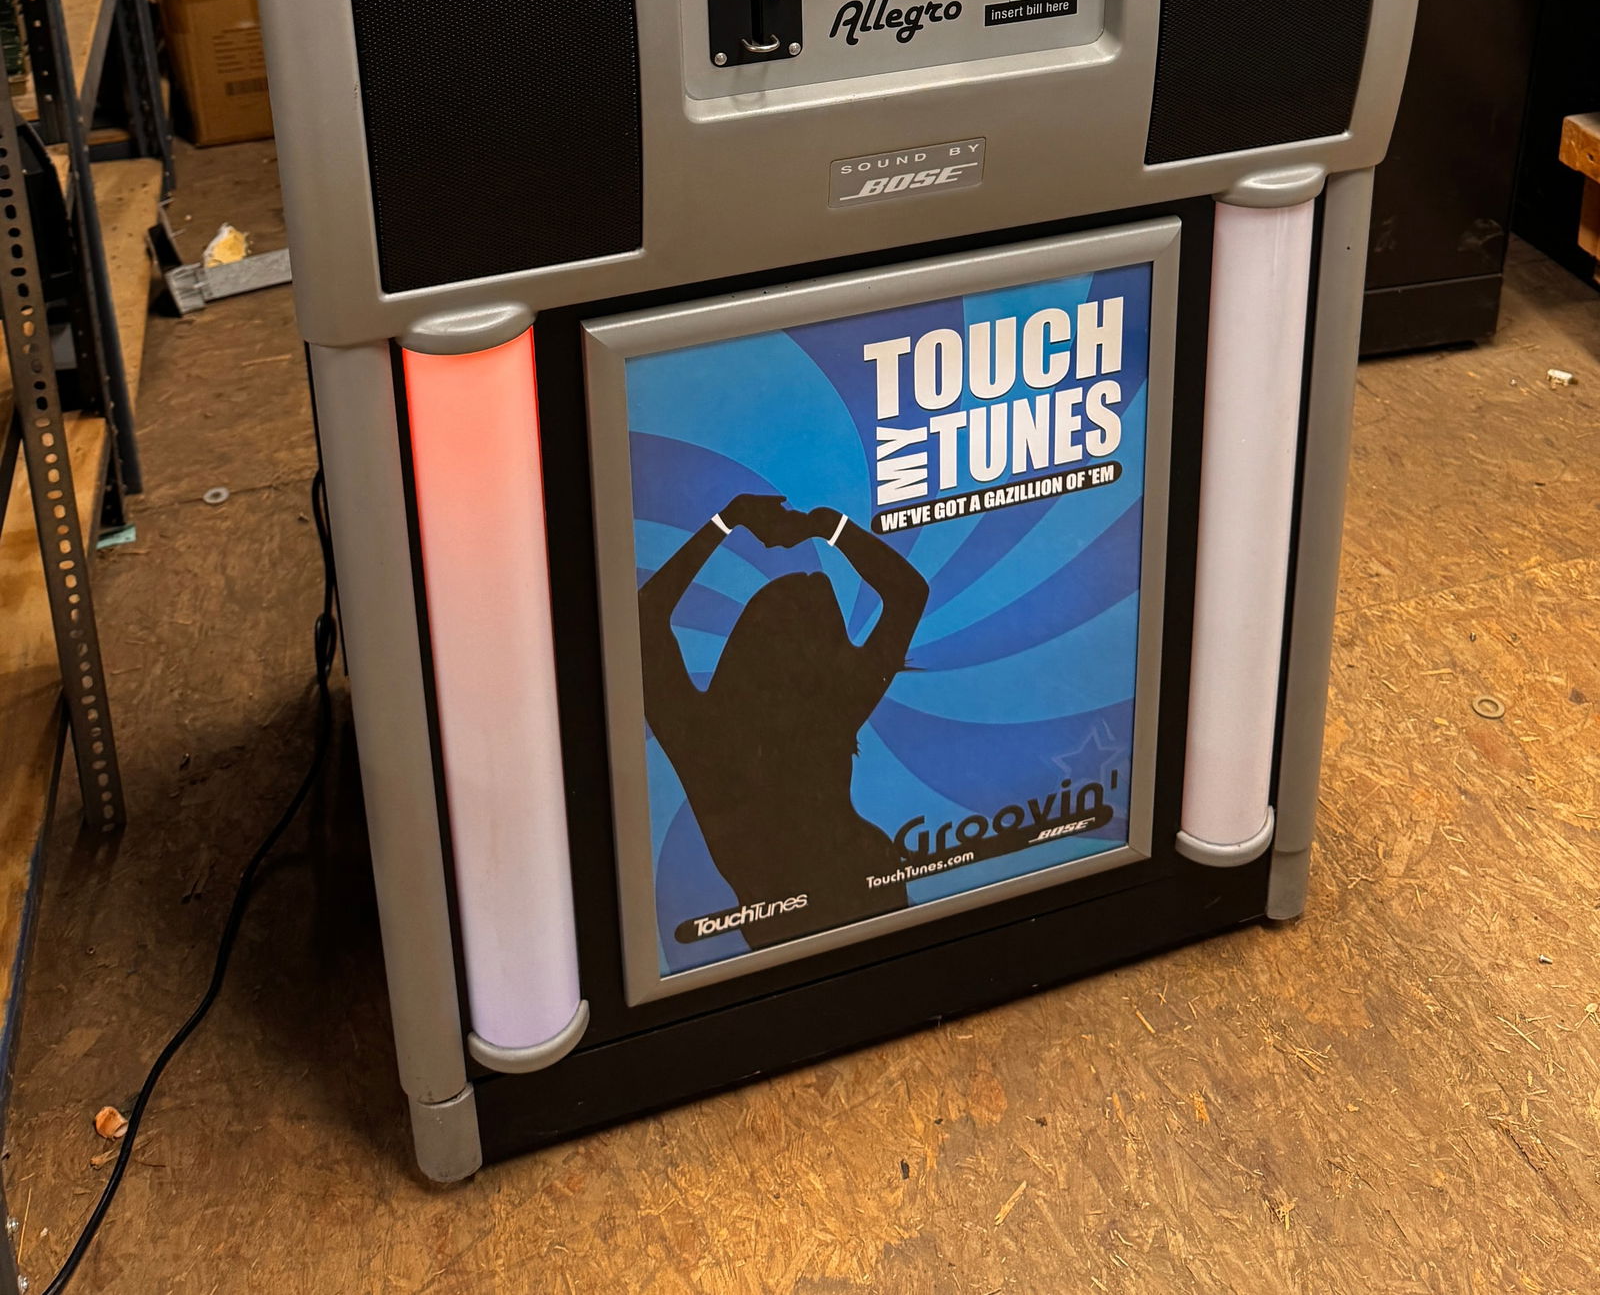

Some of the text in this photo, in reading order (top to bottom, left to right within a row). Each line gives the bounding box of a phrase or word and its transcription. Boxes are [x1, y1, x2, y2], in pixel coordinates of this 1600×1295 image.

[991, 1, 1069, 21] insert bill here
[840, 143, 980, 174] SOUND BY
[840, 162, 978, 201] BOSE
[863, 296, 1124, 420] TOUCH
[930, 380, 1122, 490] TUNES
[877, 426, 928, 506] MY
[880, 465, 1114, 533] WE'VE GOT A GAZILLION OF 'EM
[893, 769, 1118, 854] Groovin'
[1028, 817, 1095, 844] BOSE
[866, 850, 974, 889] TouchTunes.com
[694, 893, 808, 937] TouchTunes
